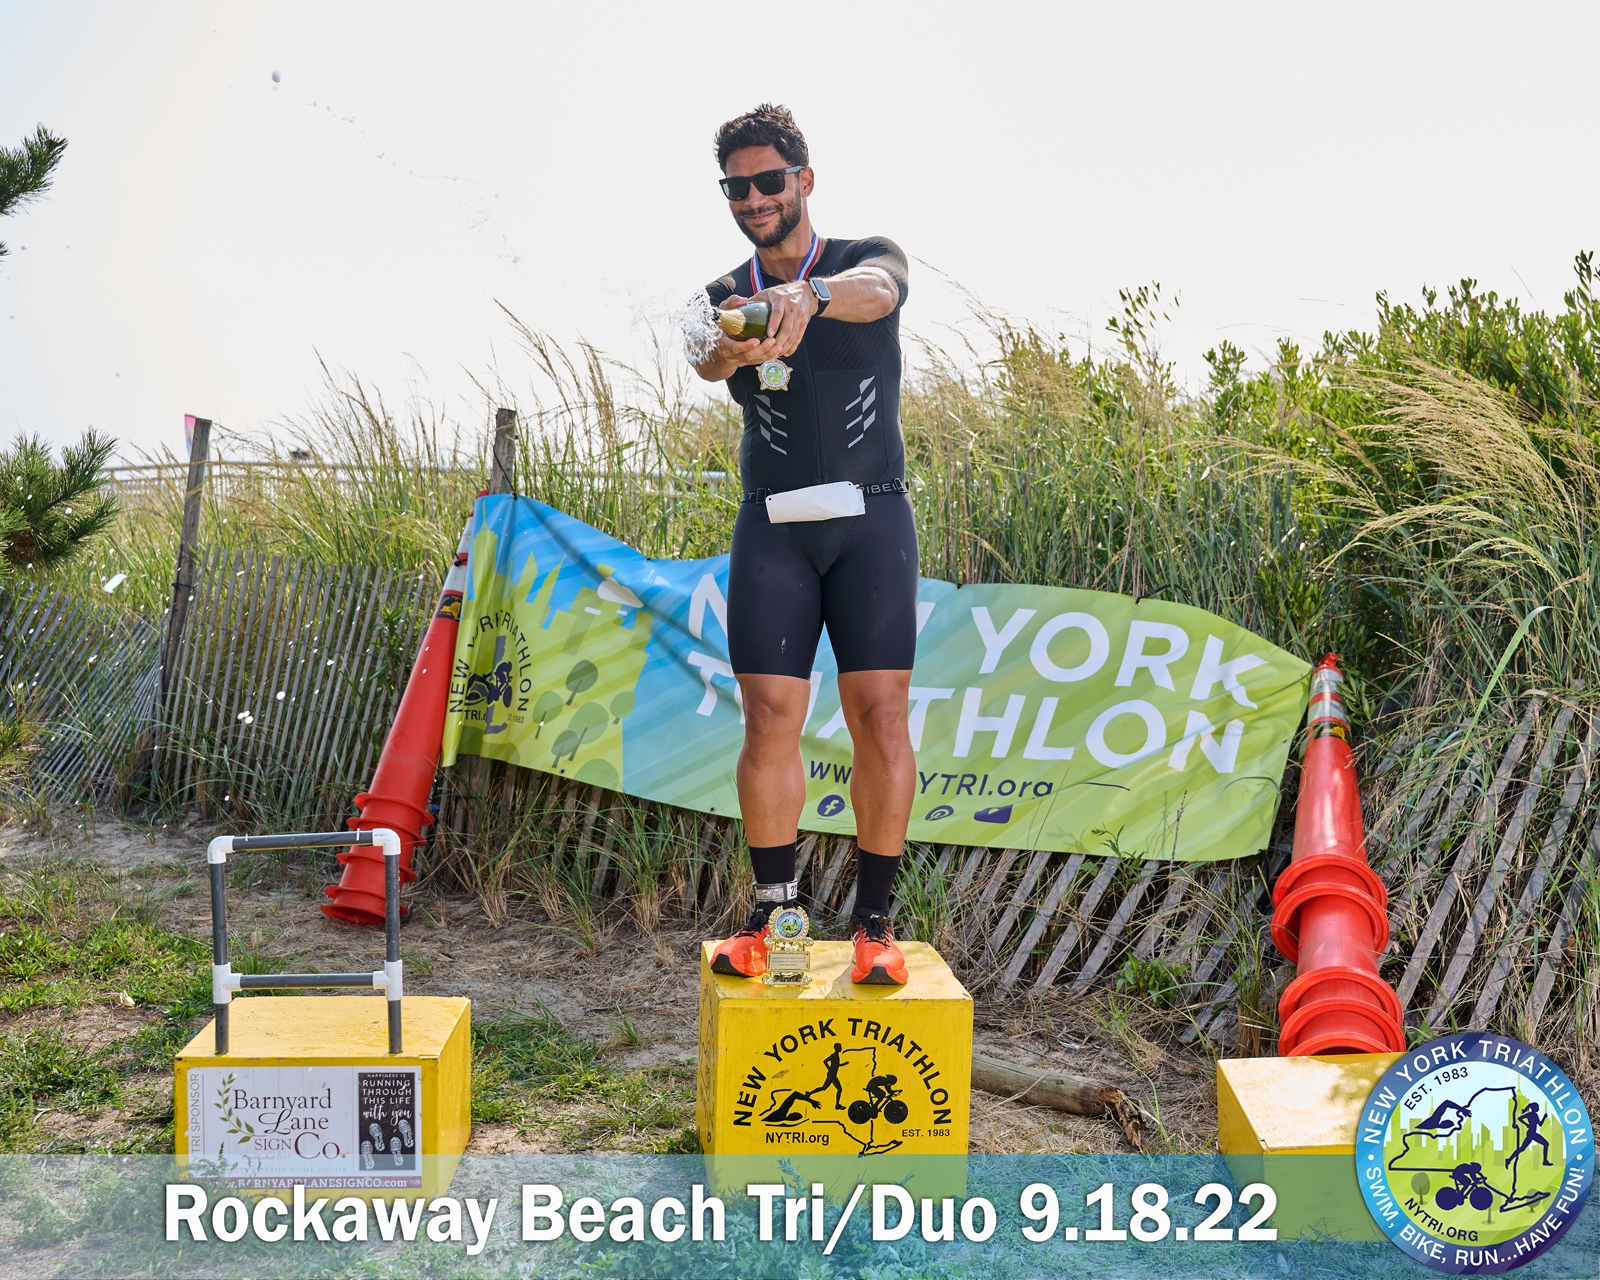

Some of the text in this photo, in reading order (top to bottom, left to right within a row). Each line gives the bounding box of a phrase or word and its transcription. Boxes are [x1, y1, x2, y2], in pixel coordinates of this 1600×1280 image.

[500, 610, 532, 712] RIATHLON
[971, 606, 1269, 711] YORK
[449, 659, 470, 713] NEW
[809, 760, 1054, 799] wwYTRI.org
[362, 1079, 411, 1087] RUNNING
[733, 1066, 767, 1127] NEW
[763, 1018, 837, 1063] YORK
[847, 1018, 952, 1125] TRIATHLON
[190, 1073, 201, 1132] SPONSOR
[233, 1088, 333, 1112] Barnyard
[362, 1088, 412, 1096] THROUGH
[363, 1097, 411, 1105] THIS LIFE
[258, 1109, 329, 1136] Lane
[362, 1104, 413, 1126] with you
[254, 1138, 292, 1151] SIGN
[765, 1131, 830, 1146] NYTRI.org
[901, 1129, 951, 1138] EST. 1983
[290, 1166, 315, 1174] HOME
[318, 1166, 347, 1174] DECOR
[209, 1177, 408, 1189] .BRNYARDLANESIGNCO.com
